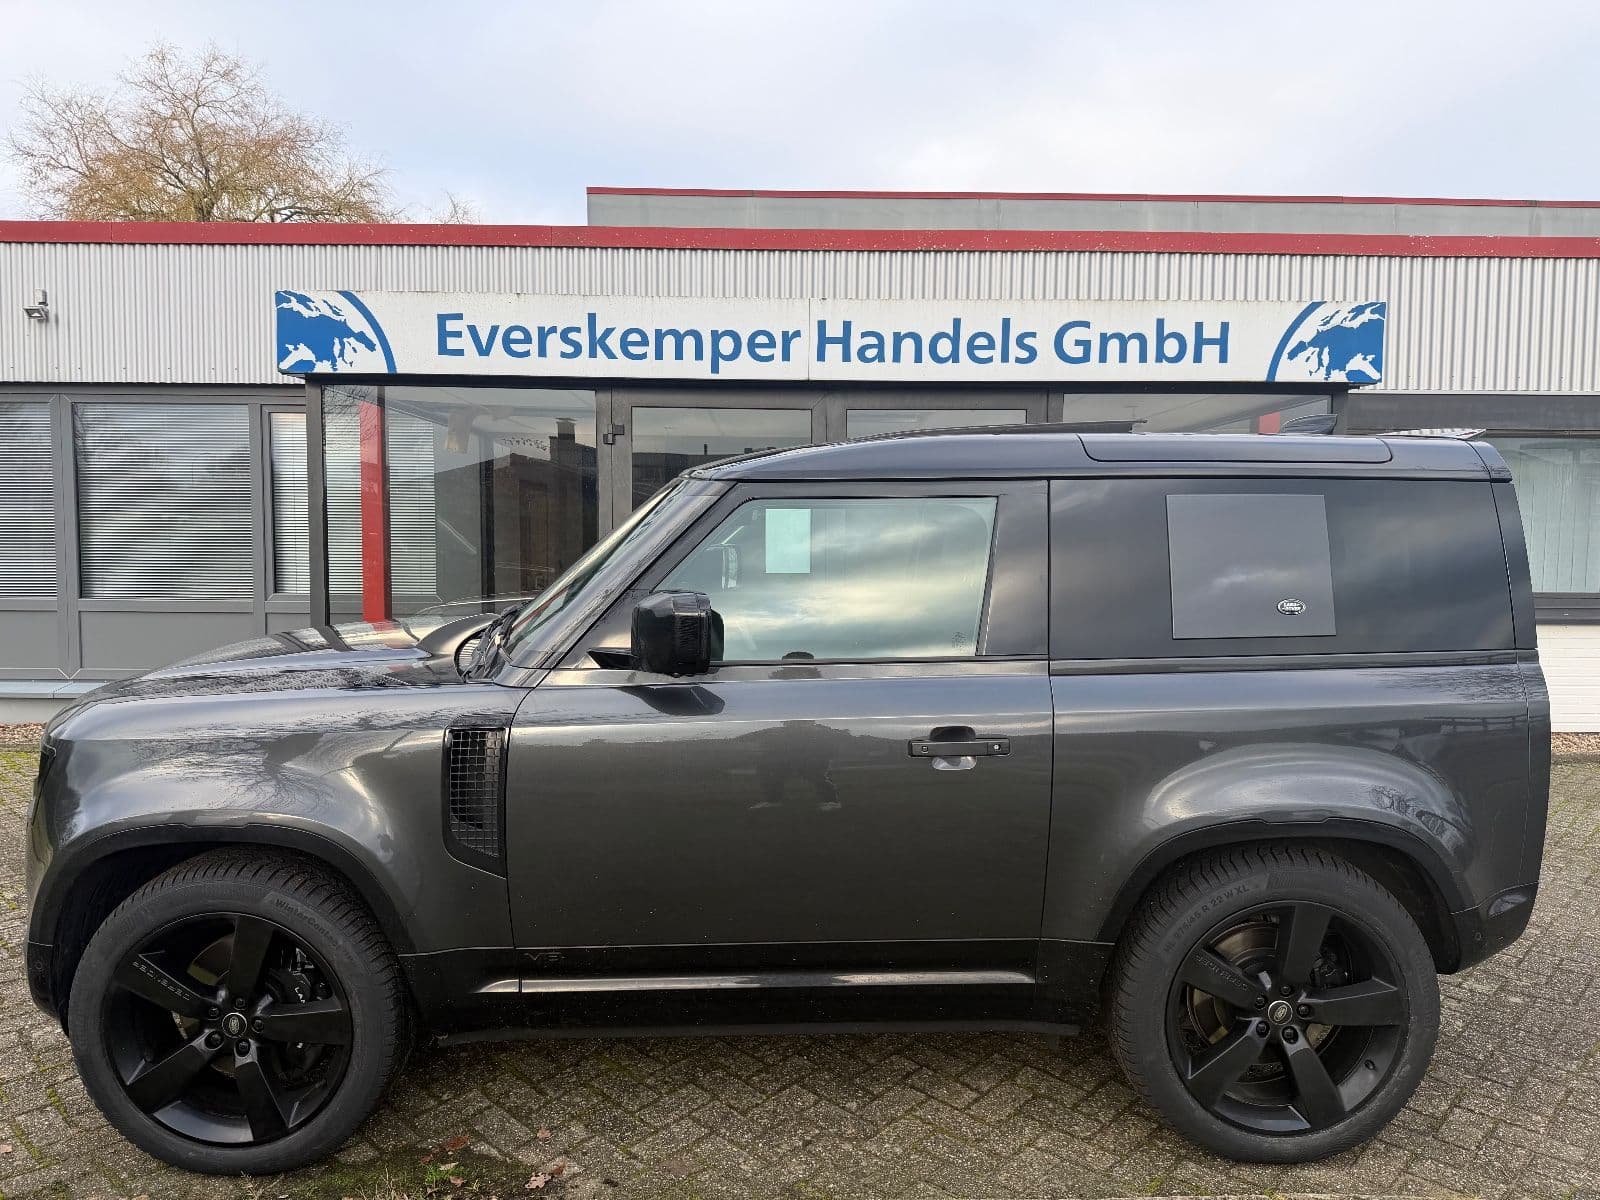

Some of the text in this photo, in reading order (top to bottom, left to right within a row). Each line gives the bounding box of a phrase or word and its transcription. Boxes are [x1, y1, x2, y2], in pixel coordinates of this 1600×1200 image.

[436, 312, 1230, 374] Everskemper Handels GmbH
[1210, 895, 1224, 907] 22
[1234, 884, 1250, 896] XL
